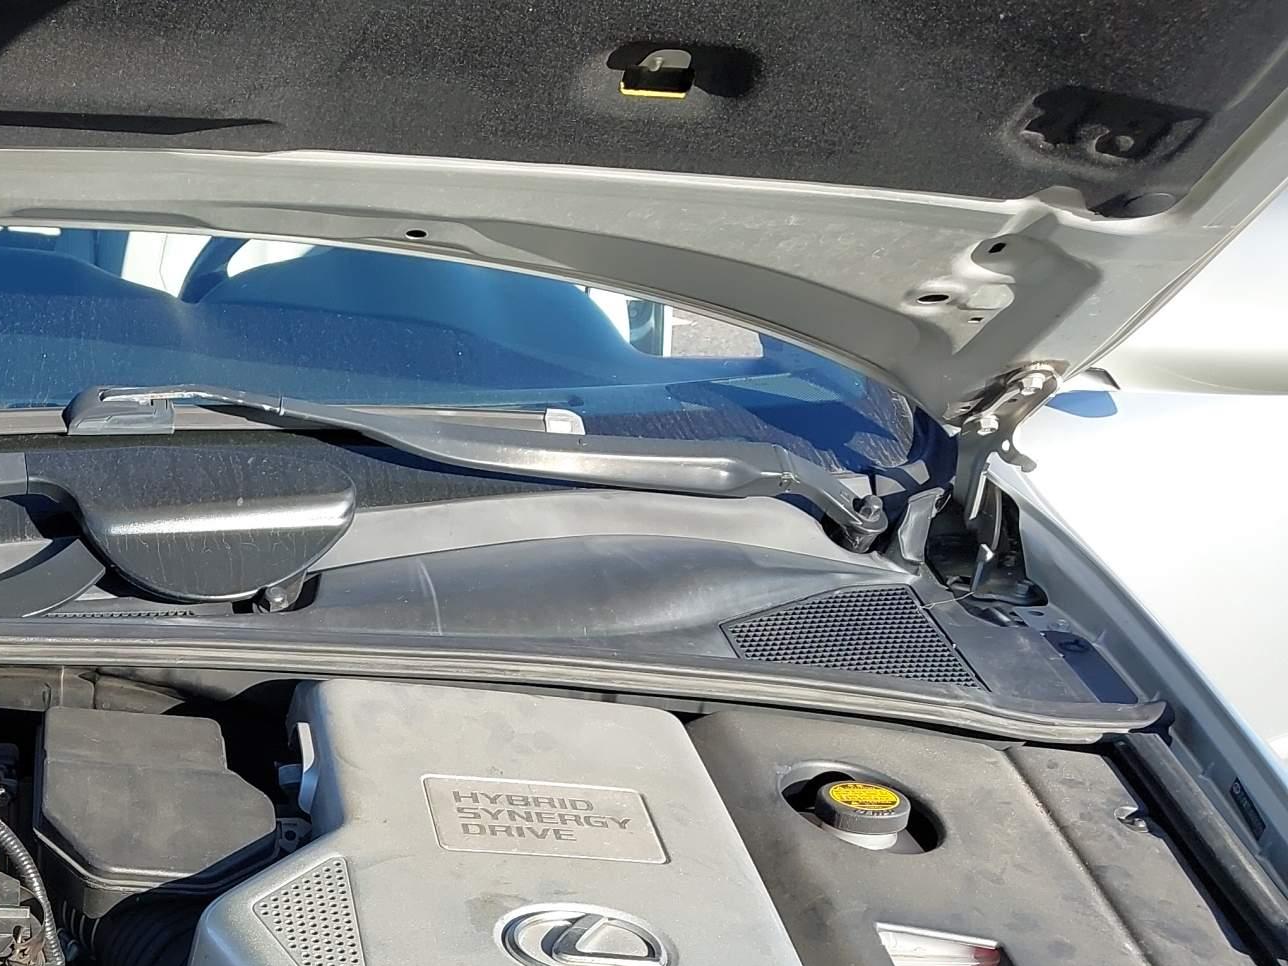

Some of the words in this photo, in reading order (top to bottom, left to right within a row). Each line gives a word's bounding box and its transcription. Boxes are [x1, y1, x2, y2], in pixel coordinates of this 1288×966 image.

[452, 790, 594, 812] HYBRID
[455, 806, 632, 830] SYNERGY
[461, 823, 577, 842] DRIVE
